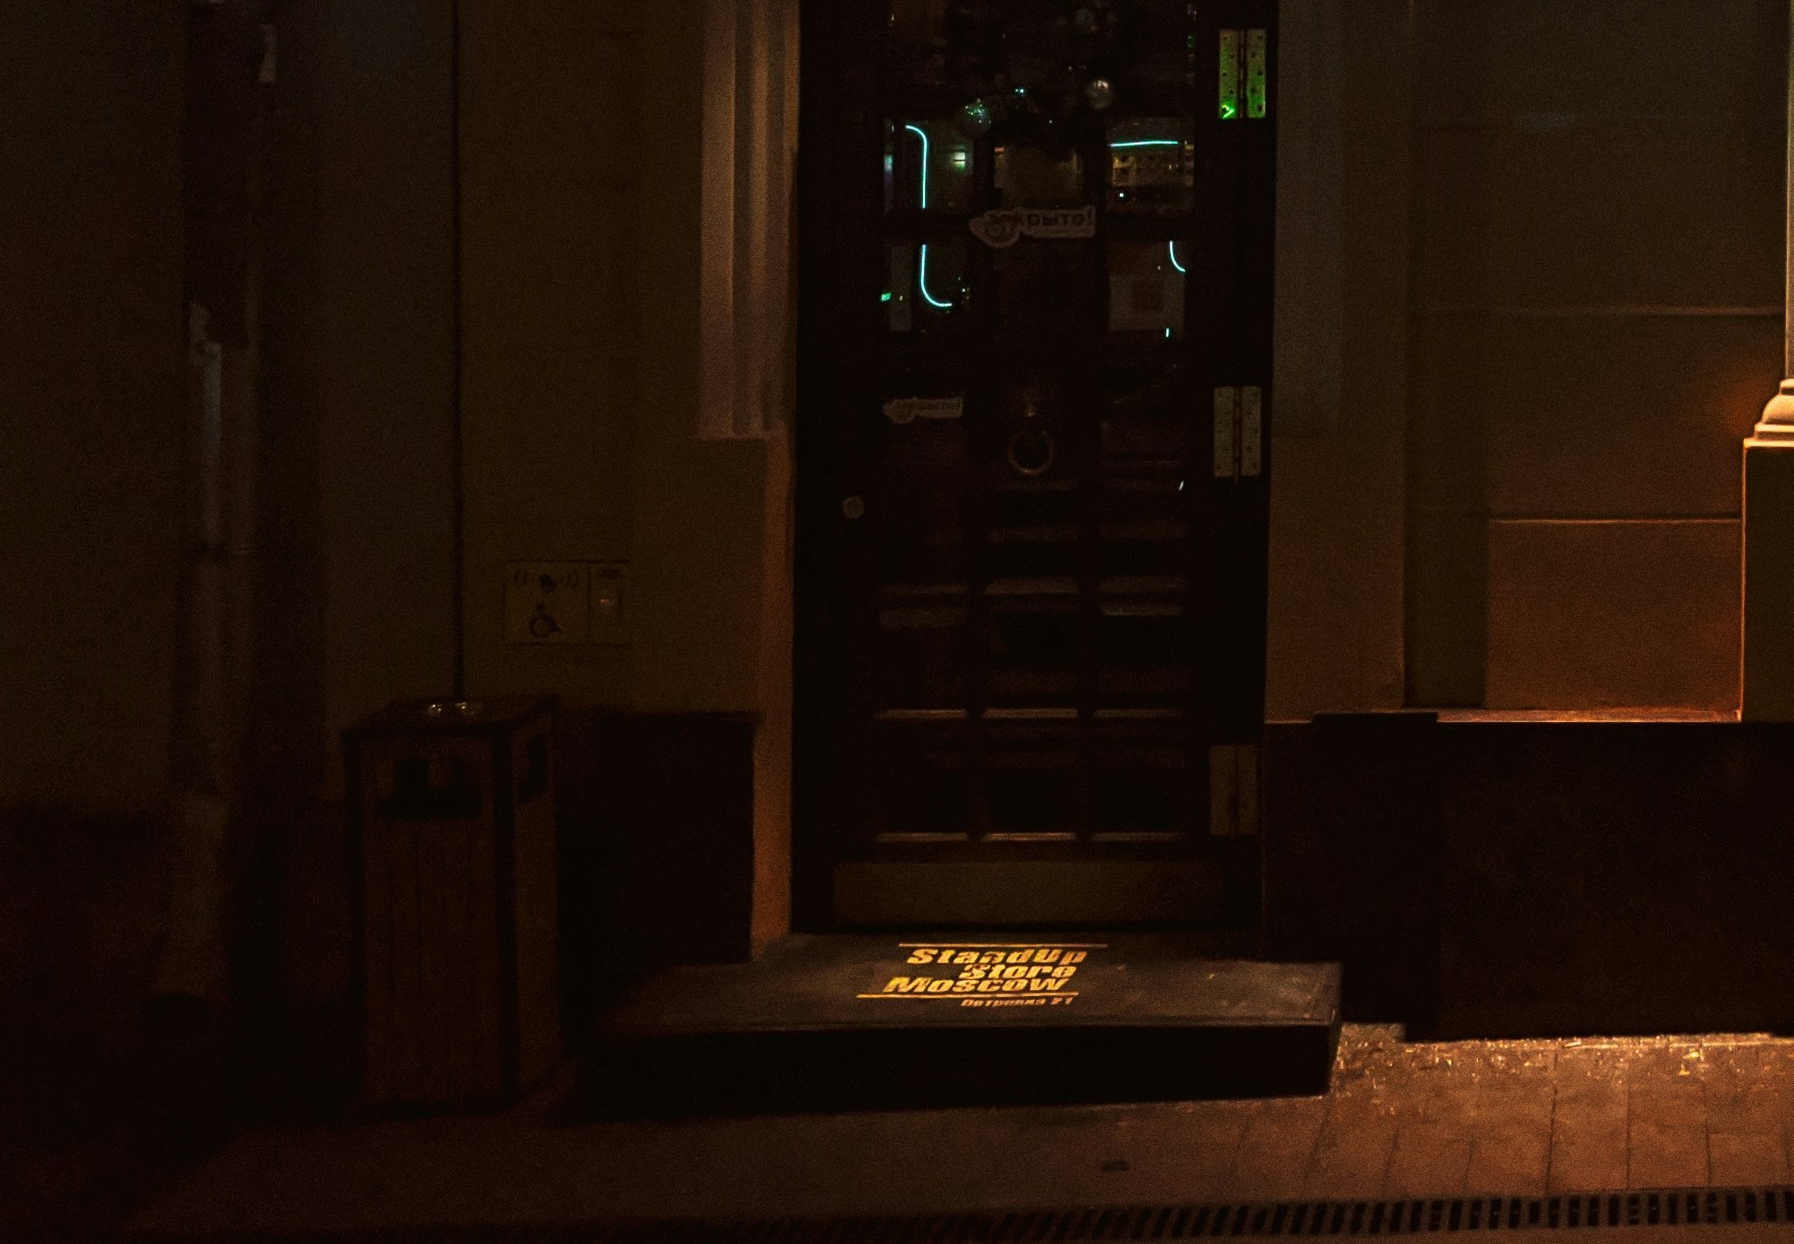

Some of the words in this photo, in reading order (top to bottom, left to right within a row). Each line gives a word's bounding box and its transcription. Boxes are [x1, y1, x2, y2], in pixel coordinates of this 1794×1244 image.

[906, 948, 1087, 966] StandUp
[958, 964, 1077, 979] Store
[882, 977, 1070, 993] Moscow
